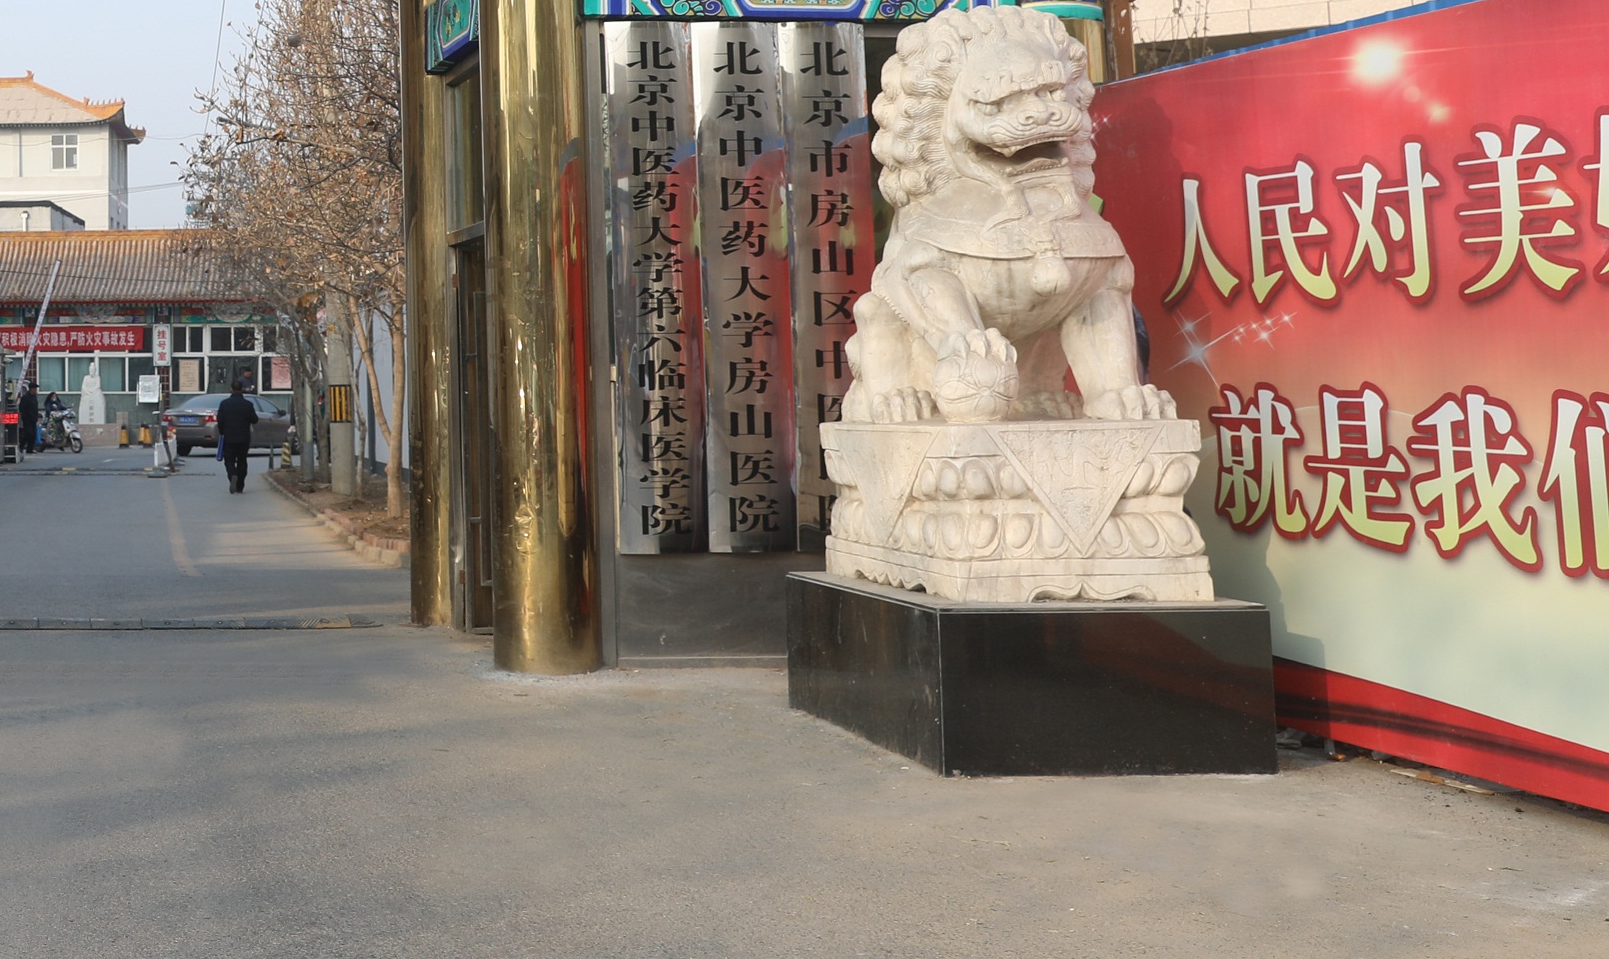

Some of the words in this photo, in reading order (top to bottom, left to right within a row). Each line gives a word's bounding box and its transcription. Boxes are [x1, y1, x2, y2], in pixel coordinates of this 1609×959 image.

[157, 329, 167, 361] 挂号室
[625, 40, 692, 537] 北京中医药大学第六临床医学院
[711, 41, 781, 534] 北京中医药大学房山医院
[798, 41, 855, 534] 北京市房山区中
